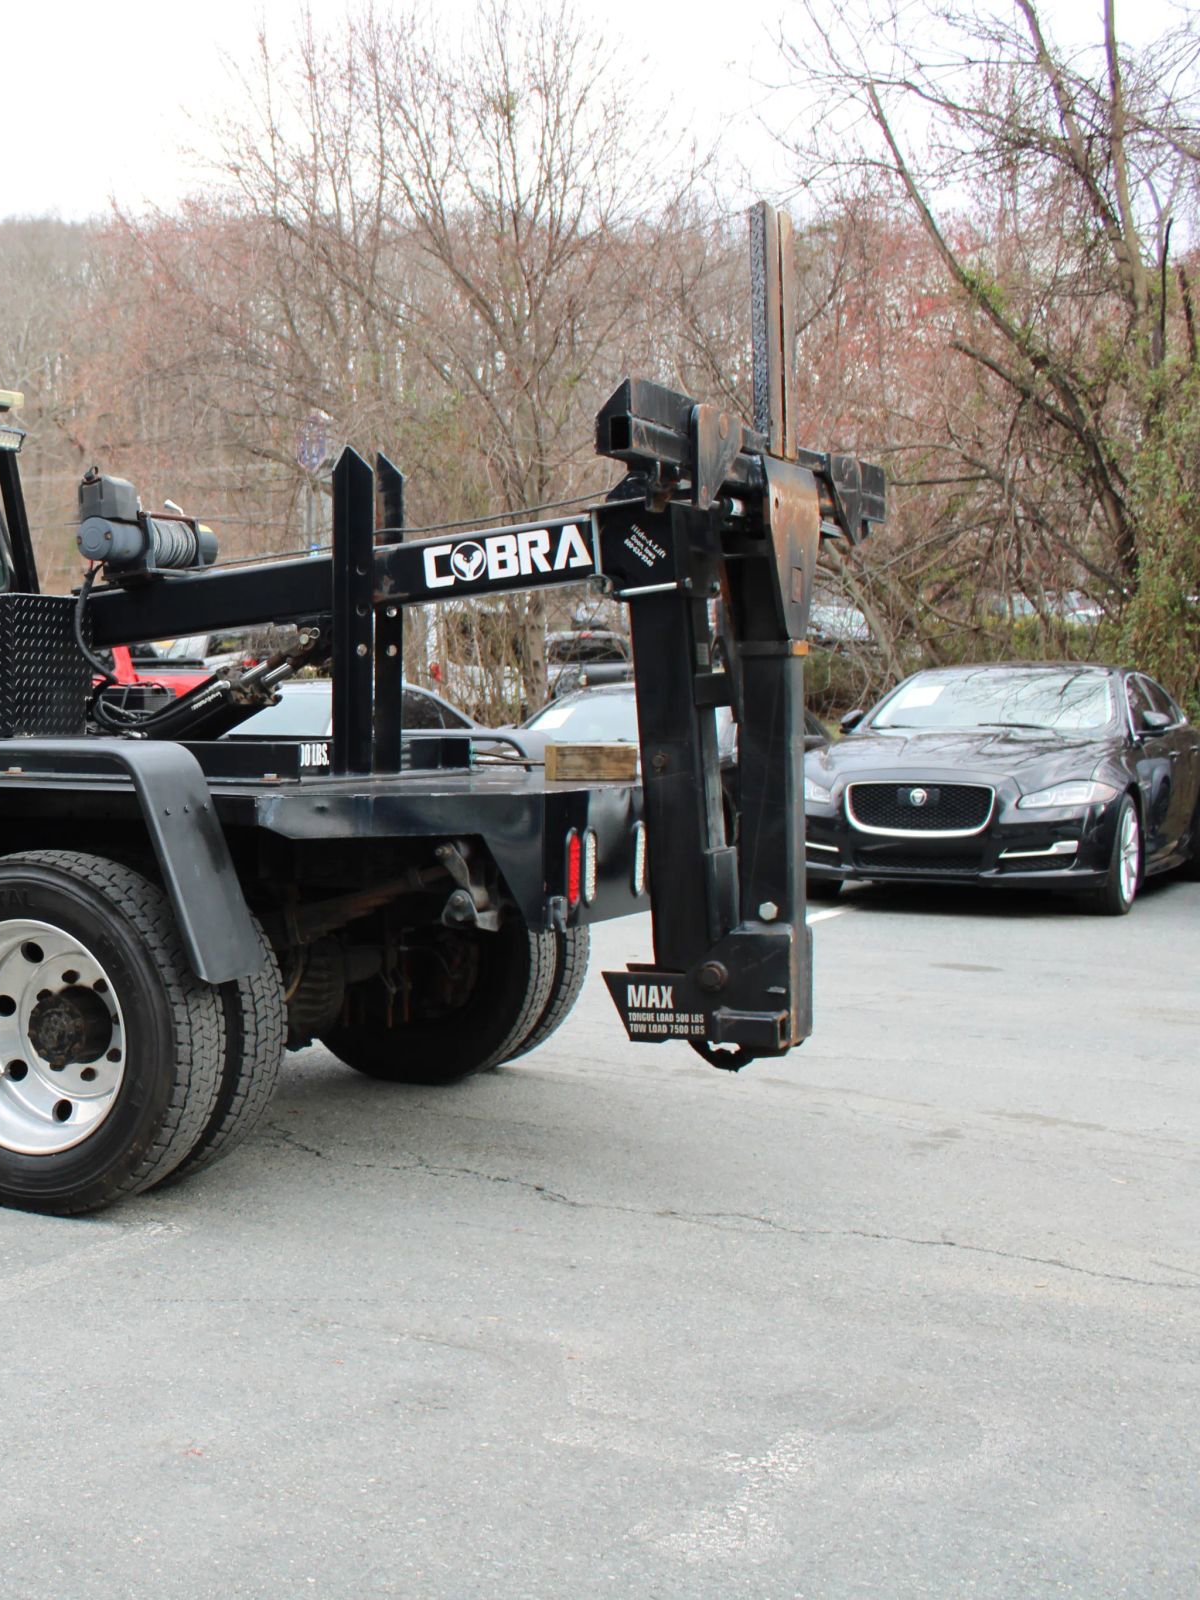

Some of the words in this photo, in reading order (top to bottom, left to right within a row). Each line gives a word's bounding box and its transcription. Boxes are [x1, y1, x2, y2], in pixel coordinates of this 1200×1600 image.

[311, 742, 330, 766] LBS.
[627, 984, 674, 1009] MAX
[628, 1012, 655, 1022] TONGUE
[656, 1013, 675, 1023] LOAD
[676, 1013, 689, 1023] 500
[691, 1014, 704, 1024] LBS
[629, 1023, 646, 1033] TOW
[648, 1024, 668, 1033] LOAD
[669, 1024, 689, 1034] 7500
[691, 1025, 705, 1035] LBS
